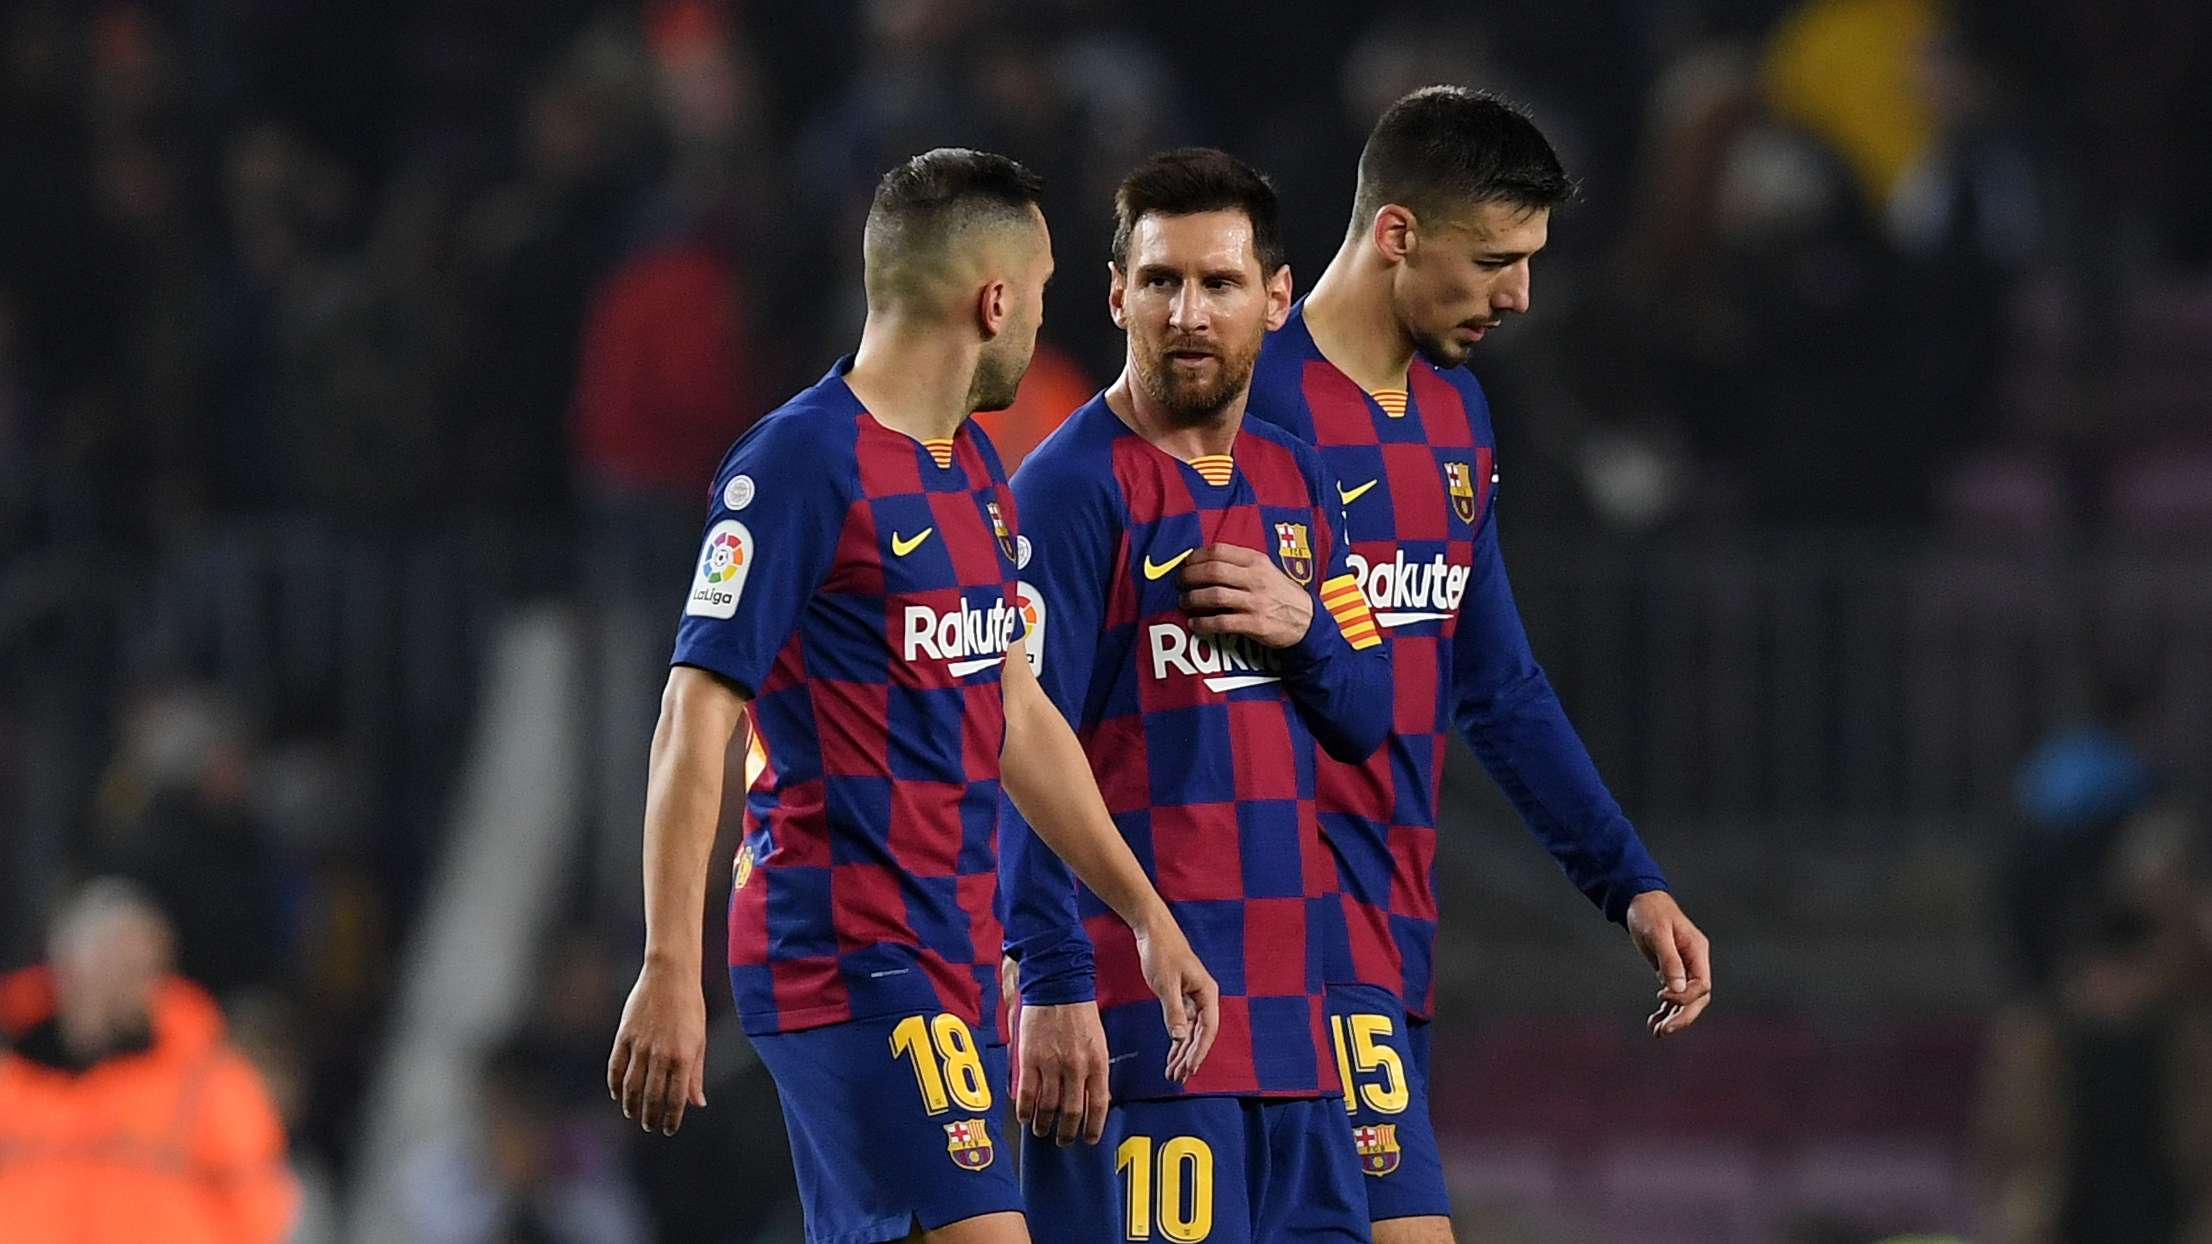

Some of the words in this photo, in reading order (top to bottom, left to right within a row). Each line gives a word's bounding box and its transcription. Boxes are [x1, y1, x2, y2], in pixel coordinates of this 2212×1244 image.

[693, 587, 733, 605] LaLiga
[1345, 549, 1471, 610] Rakute
[904, 597, 1016, 661] Rakute
[889, 1012, 992, 1116] 18
[1330, 1014, 1409, 1115] 15
[1114, 1135, 1213, 1244] 10
